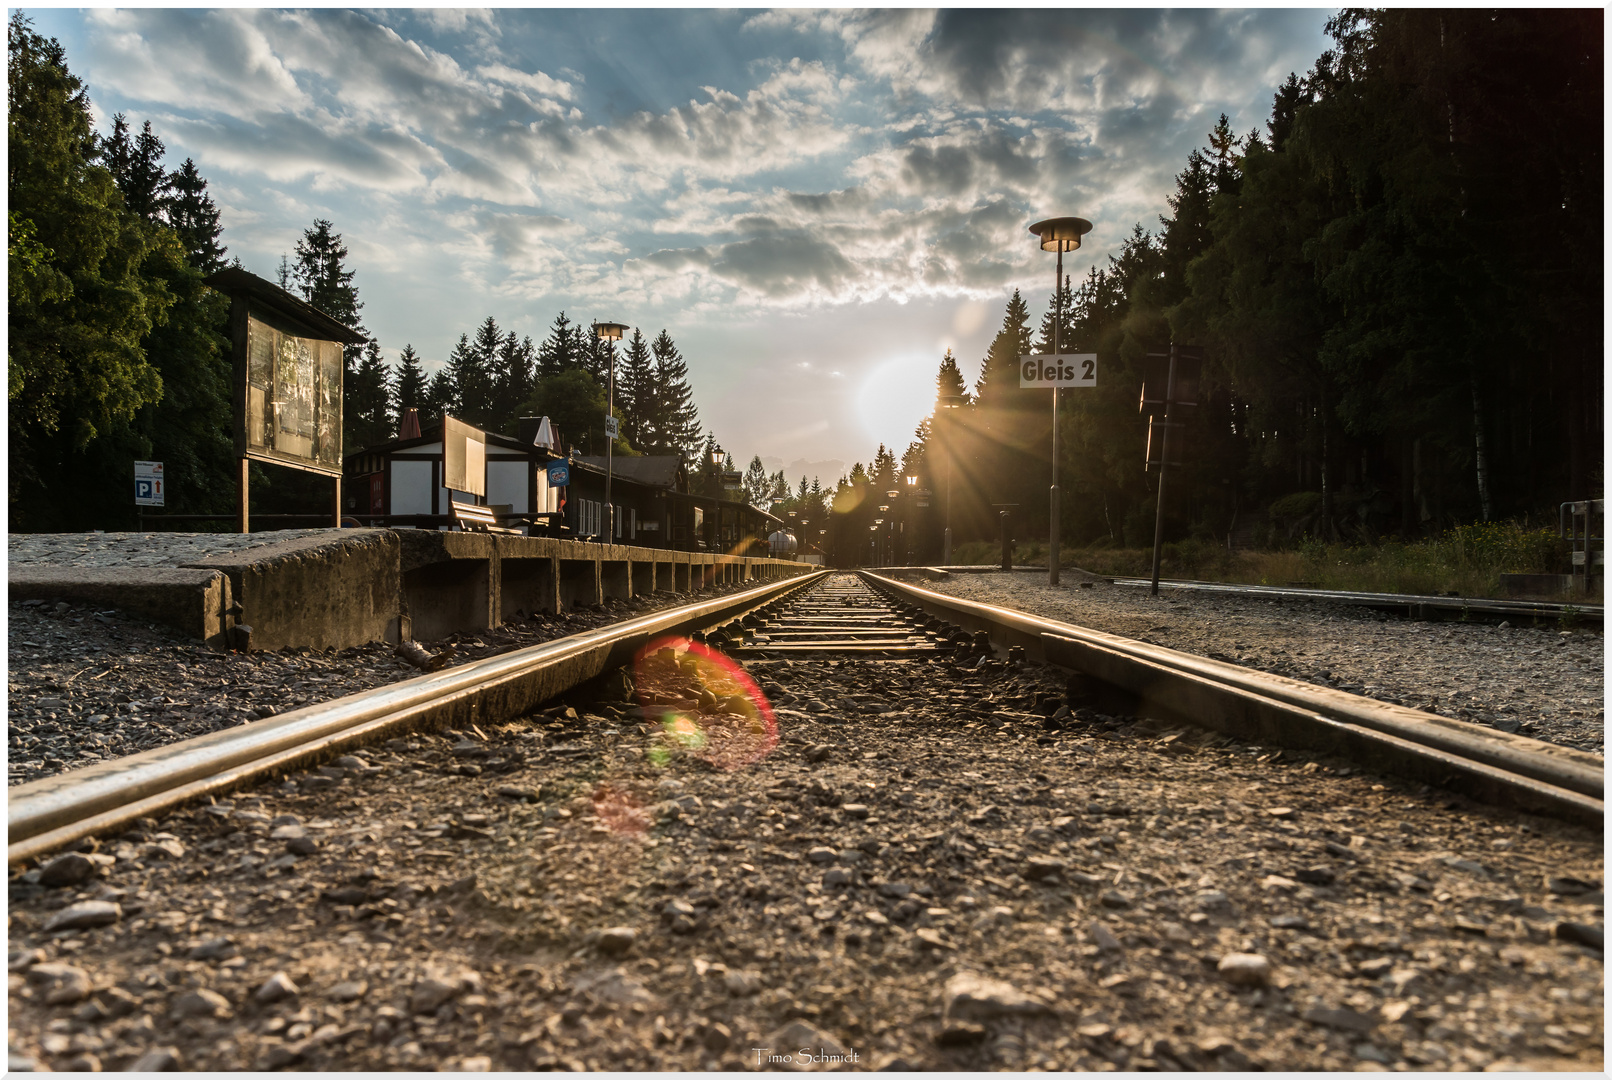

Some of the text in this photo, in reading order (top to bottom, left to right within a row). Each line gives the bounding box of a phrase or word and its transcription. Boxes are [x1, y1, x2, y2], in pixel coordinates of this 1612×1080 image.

[1022, 359, 1095, 381] Gleis 2
[139, 483, 149, 496] P
